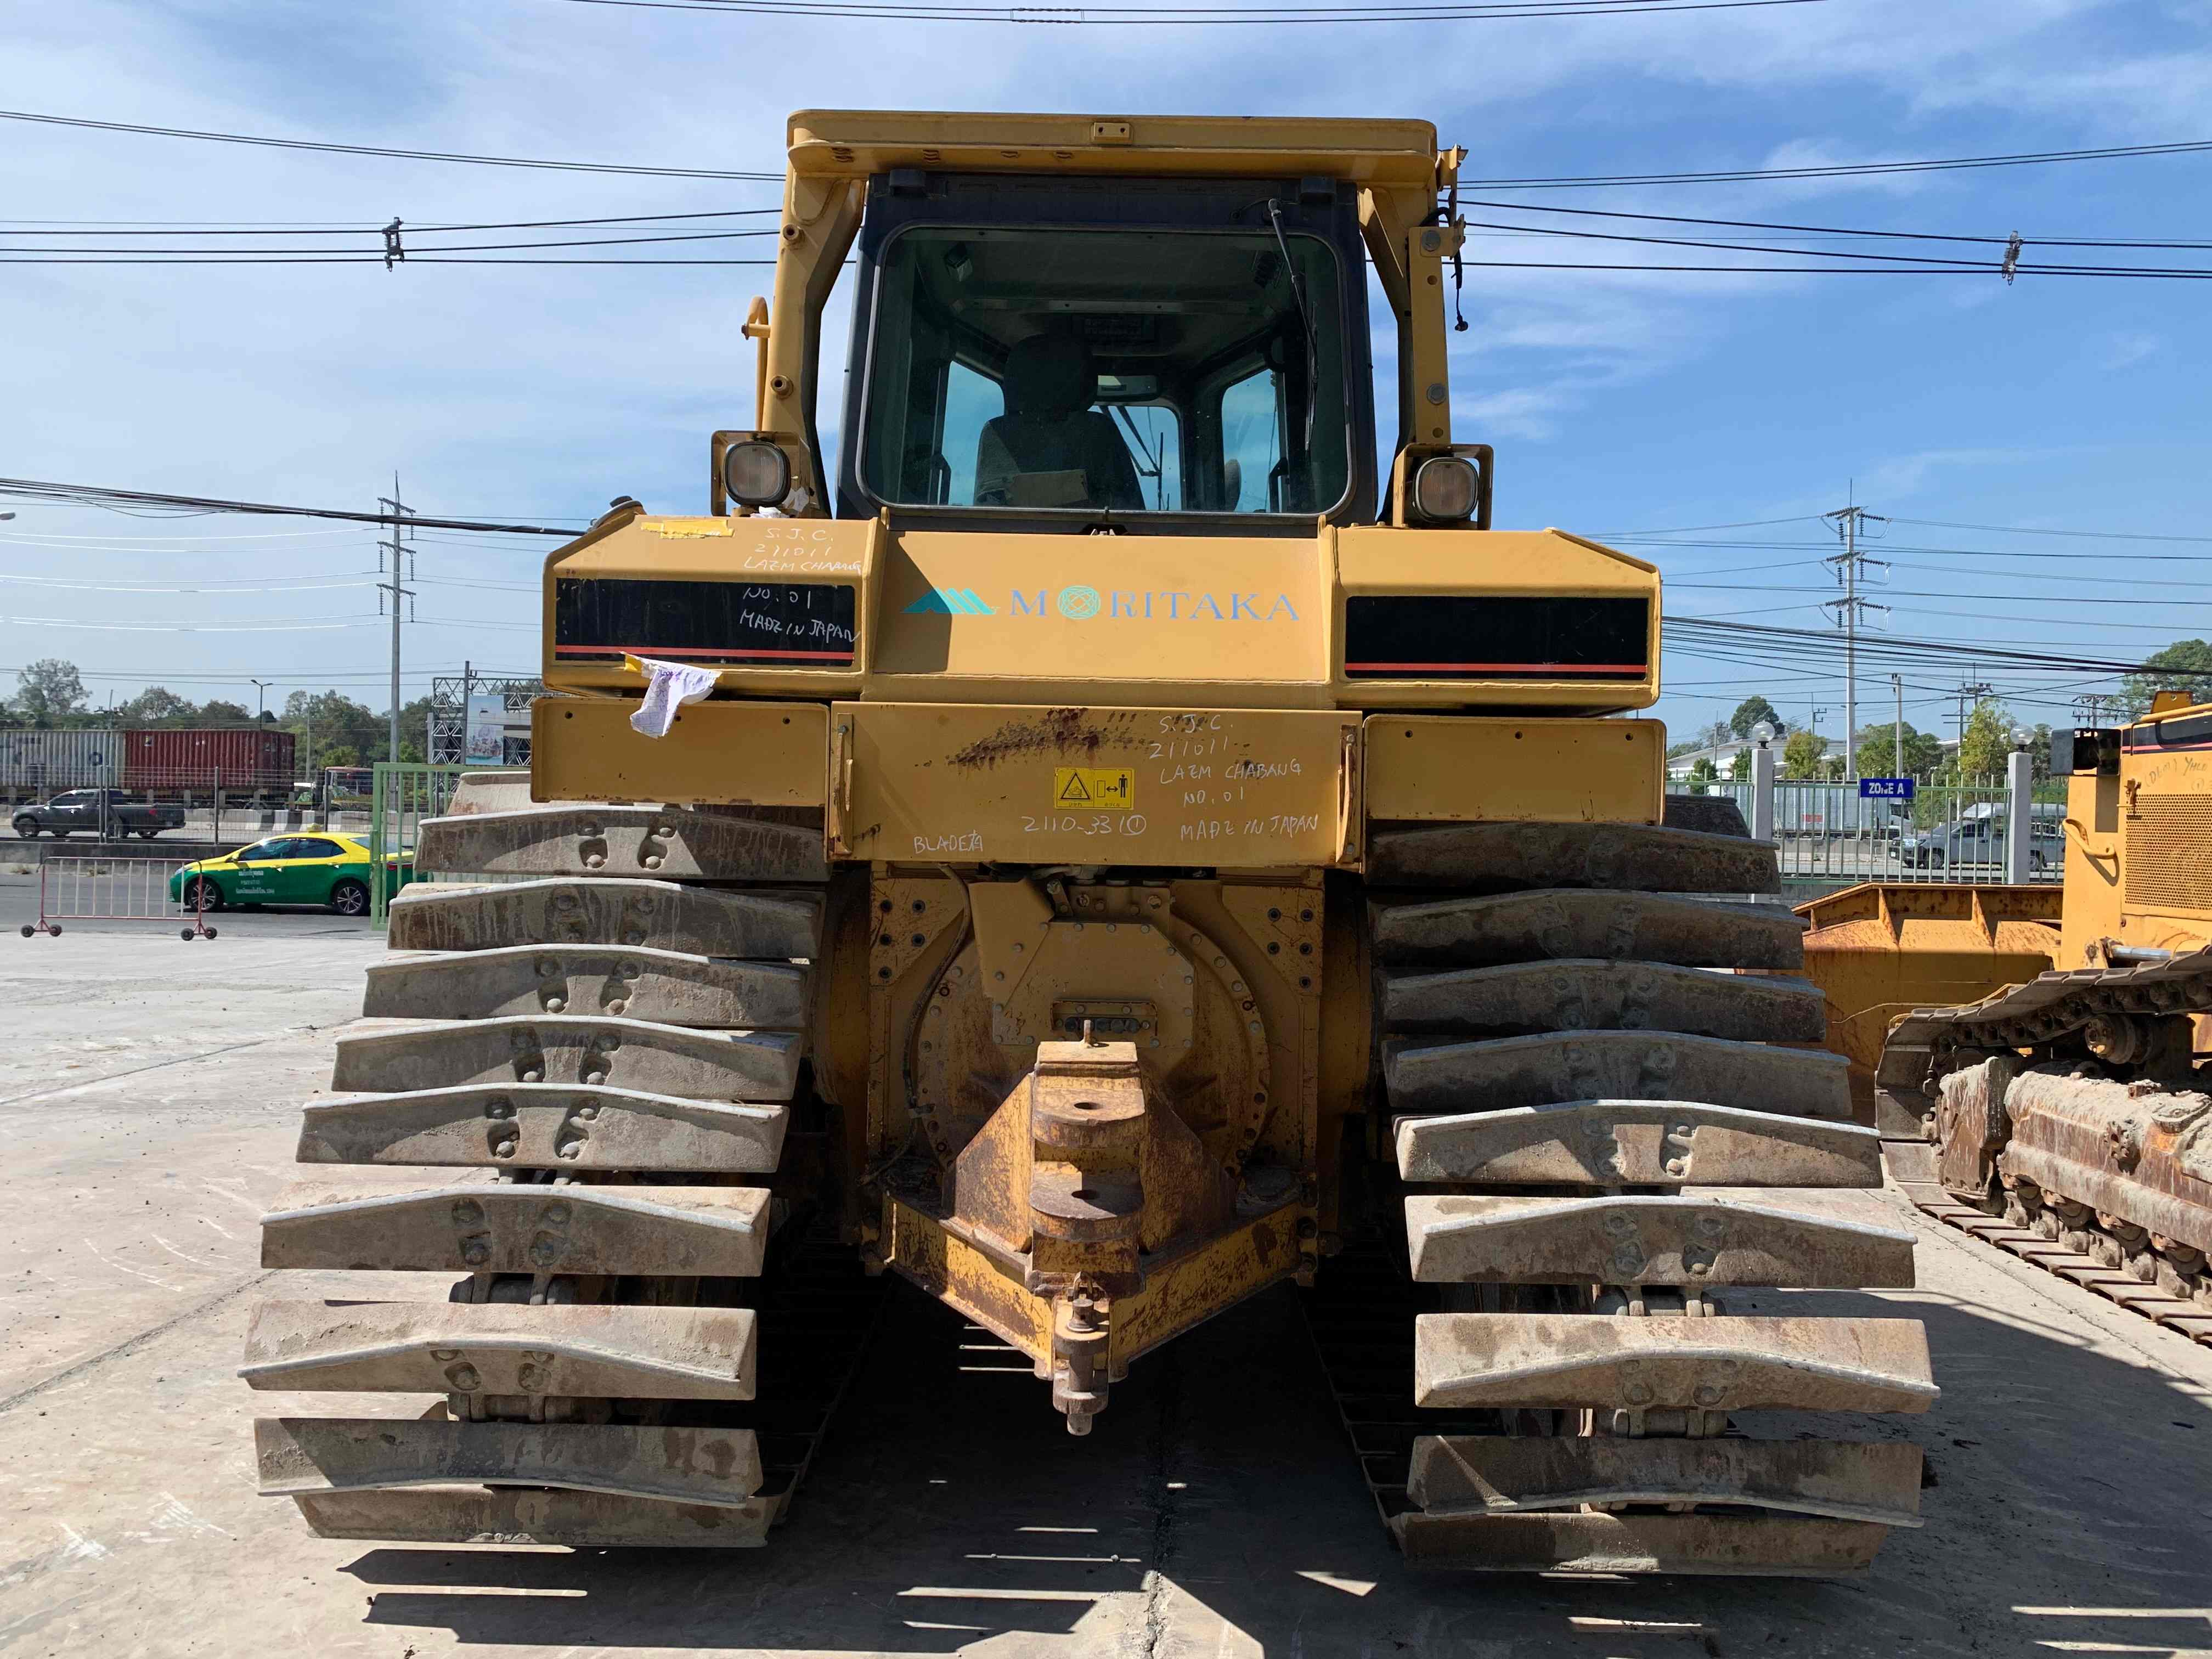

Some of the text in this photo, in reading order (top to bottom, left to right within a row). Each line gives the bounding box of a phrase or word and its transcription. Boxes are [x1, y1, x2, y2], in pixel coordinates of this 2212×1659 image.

[1009, 585, 1300, 621] MORITAKA
[786, 623, 805, 635] IN
[809, 619, 860, 644] JAPAN
[1226, 758, 1301, 780] CHABANG
[1897, 782, 1904, 794] A
[1244, 819, 1263, 834] IN
[1271, 814, 1318, 838] JAPAN
